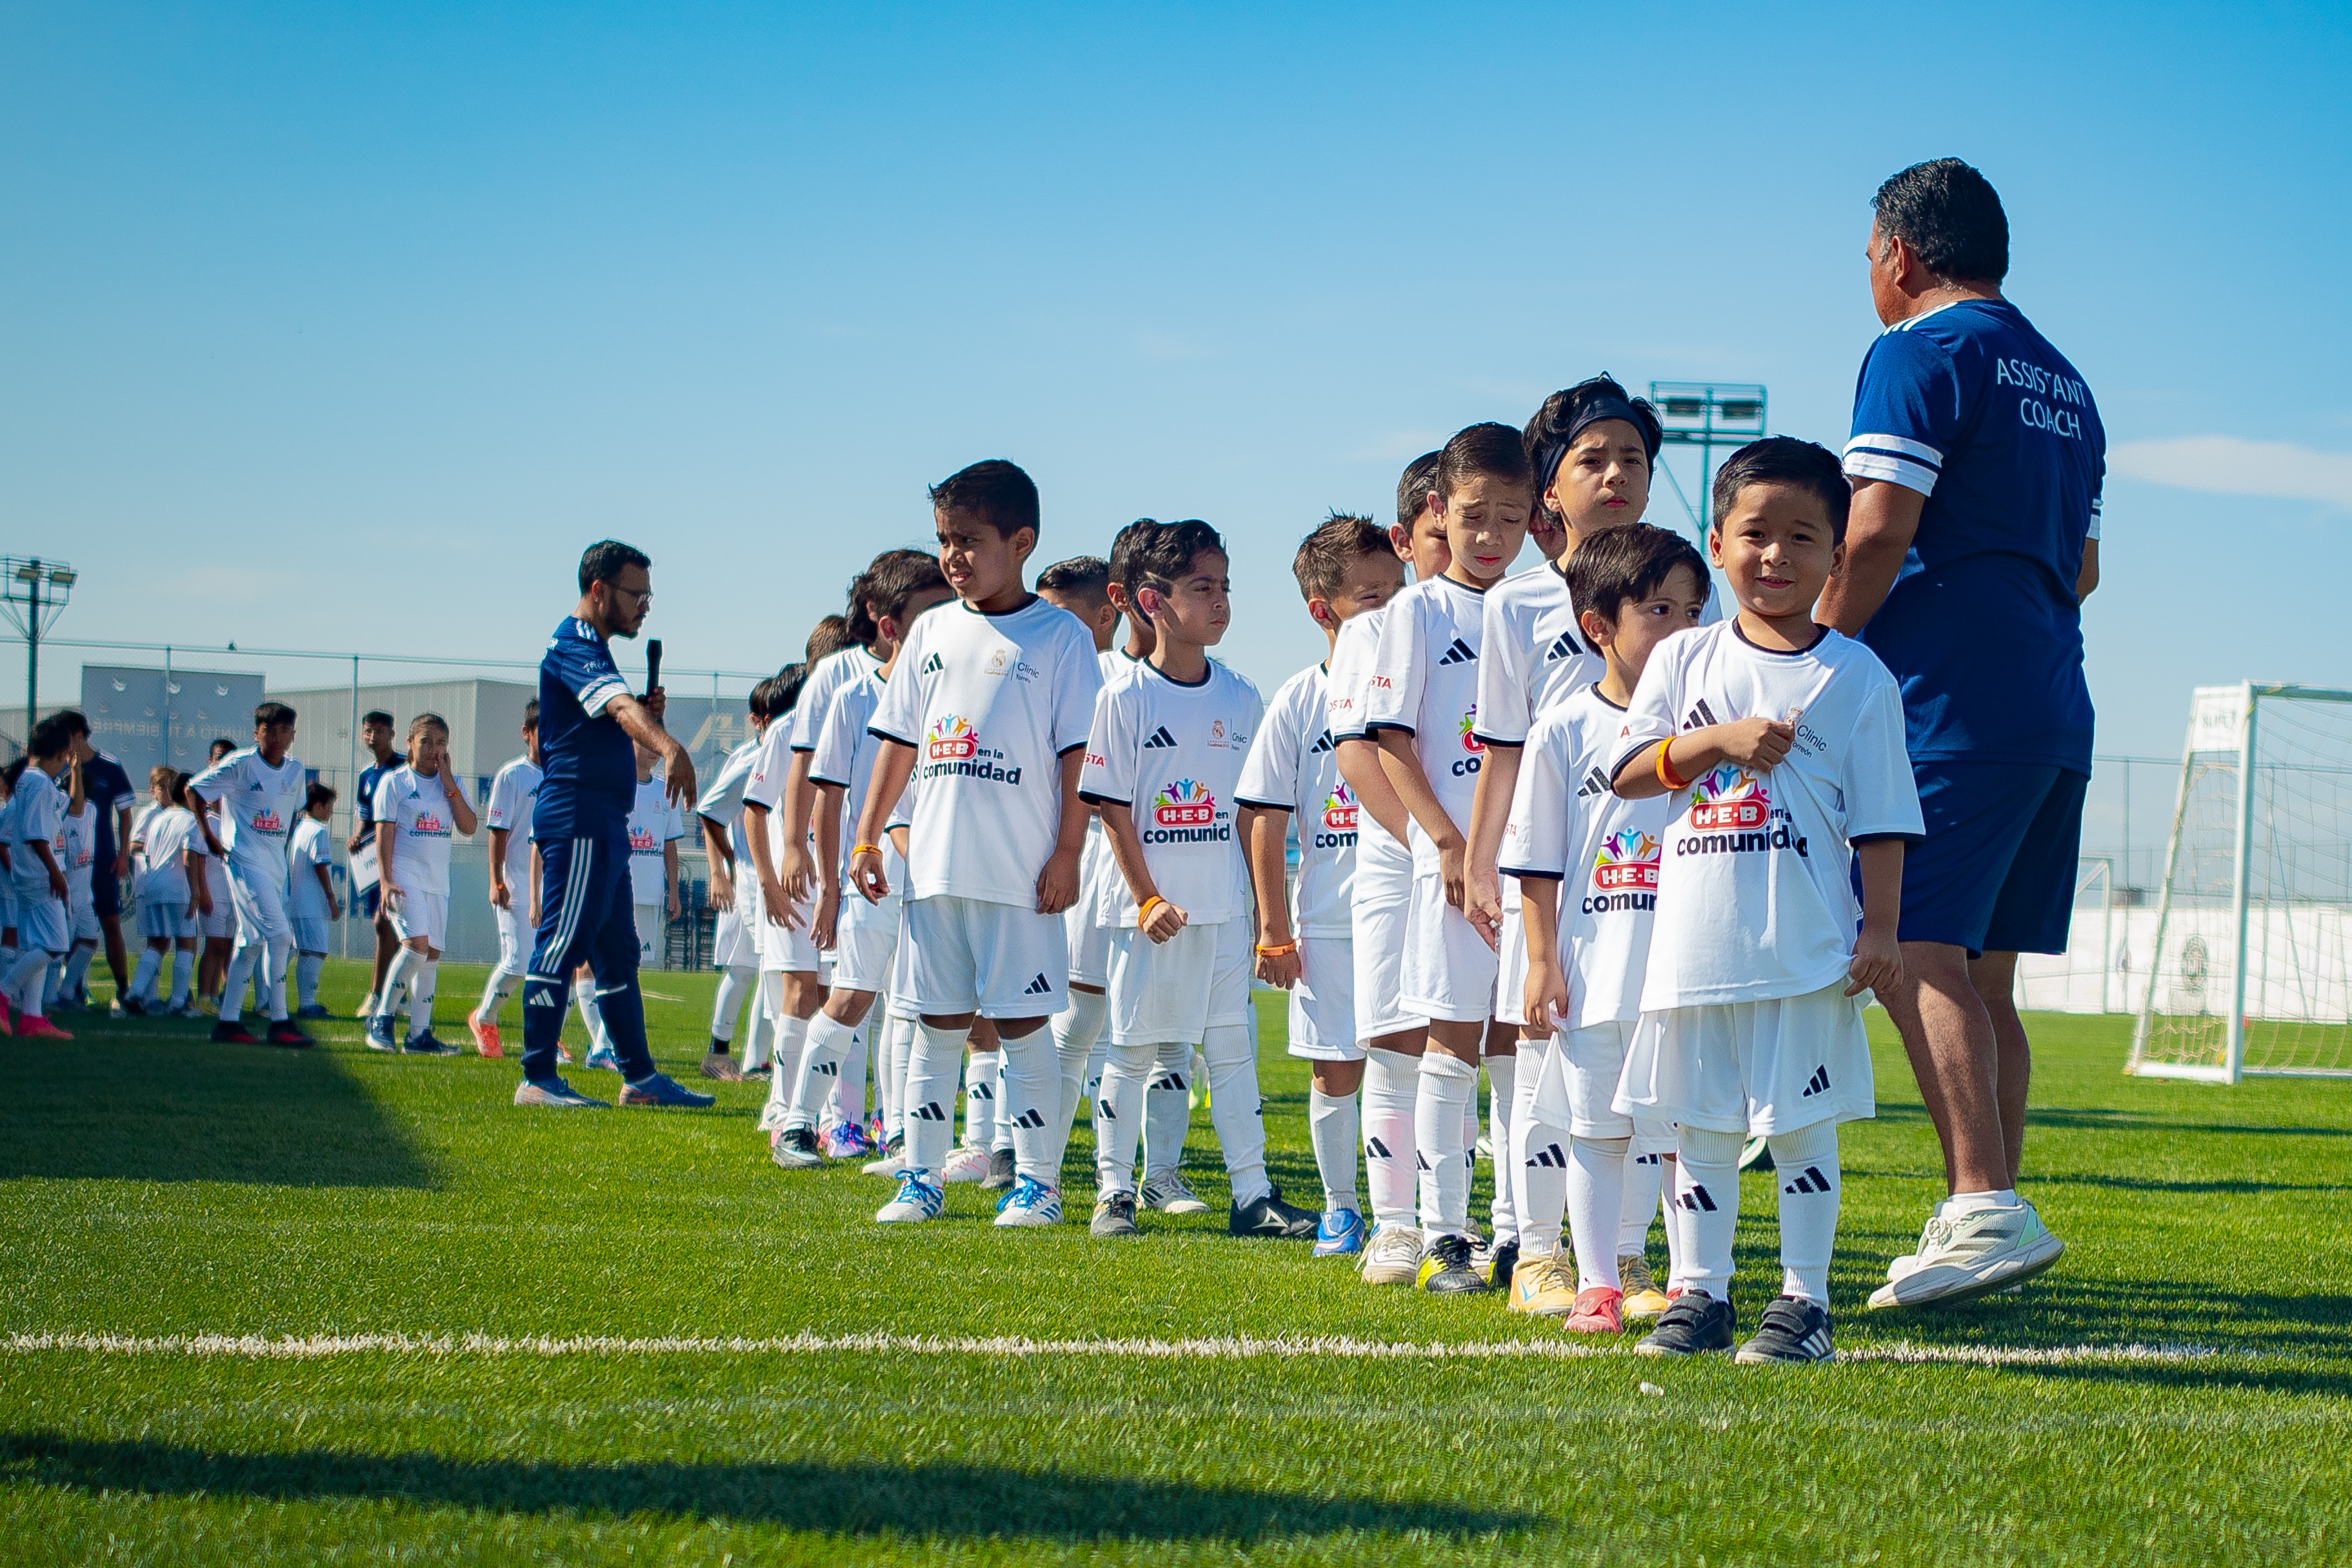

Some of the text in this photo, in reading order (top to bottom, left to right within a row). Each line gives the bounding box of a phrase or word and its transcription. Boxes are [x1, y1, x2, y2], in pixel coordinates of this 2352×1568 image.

[1997, 358, 2086, 408] ASSISTANT
[2020, 397, 2082, 441] COACH
[1017, 662, 1039, 679] Clinic
[1792, 739, 1812, 759] orreón
[1797, 724, 1827, 751] Clinic
[977, 748, 992, 757] en
[993, 748, 1004, 760] la
[923, 759, 1022, 786] comunidad
[1215, 811, 1229, 819] en
